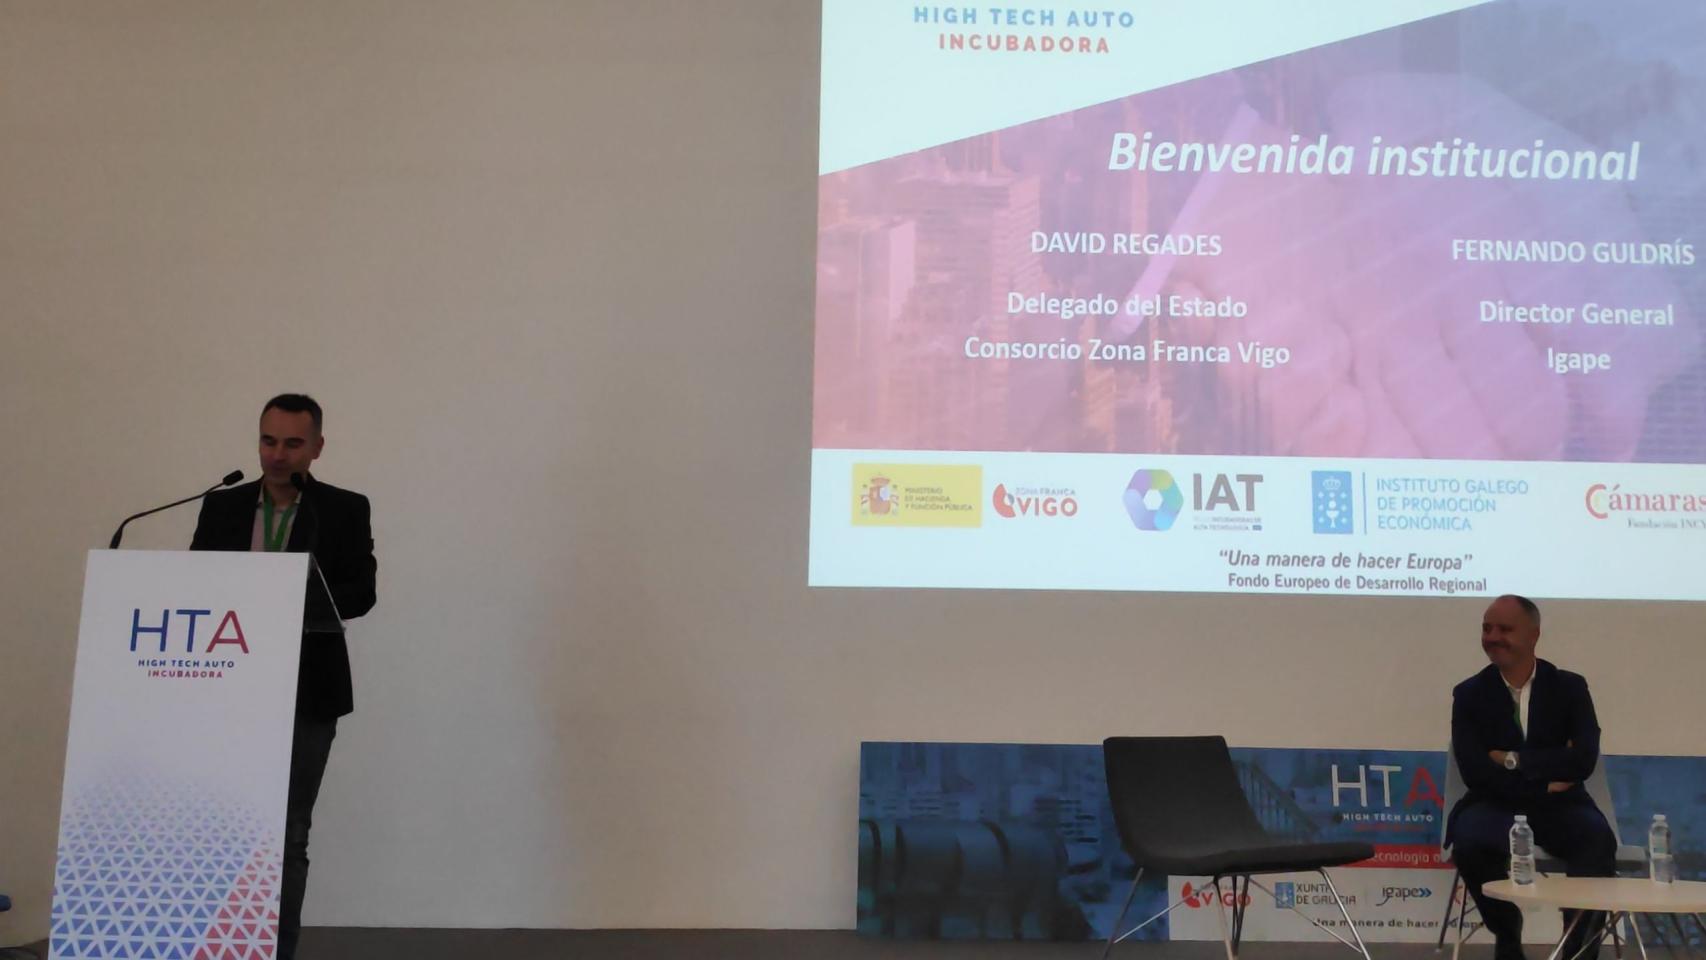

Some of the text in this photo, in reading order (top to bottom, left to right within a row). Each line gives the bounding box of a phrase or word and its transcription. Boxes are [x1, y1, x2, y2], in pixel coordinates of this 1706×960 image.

[914, 6, 1135, 28] HIGH TECH AUTO
[939, 33, 1110, 54] INCUBADORA
[1108, 131, 1640, 181] Bienvenida institucional
[1031, 231, 1223, 256] DAVID REGADES
[1452, 238, 1696, 265] FERNANDO GULDRÍS
[1007, 291, 1248, 319] Delegado del Estado
[1479, 300, 1674, 326] Director General
[964, 336, 1290, 368] Consorcio Zona Franca Vigo
[1547, 348, 1611, 373] Igape
[1193, 473, 1264, 511] IAT
[1376, 477, 1529, 496] INSTITUTO GALEGO
[1016, 497, 1078, 517] VIGO
[1377, 494, 1496, 513] DE PROMOCIÓN
[1585, 483, 1706, 519] Cámaras
[1377, 511, 1473, 531] ECONÓMICA
[1266, 553, 1326, 568] manera
[1331, 552, 1351, 568] de
[1357, 552, 1402, 569] hacer
[1228, 573, 1487, 593] Fondo Europeo de Desarrollo Regional
[129, 608, 250, 654] HTA
[137, 659, 235, 668] HIGH TECH AUTO
[147, 669, 223, 679] INCUBADORA
[1331, 763, 1445, 809] HTA
[1342, 813, 1434, 823] HIGH TECH AUTO
[1201, 892, 1252, 907] VGO
[1296, 895, 1309, 905] DE
[1388, 918, 1403, 929] de
[1406, 918, 1439, 928] hacer
